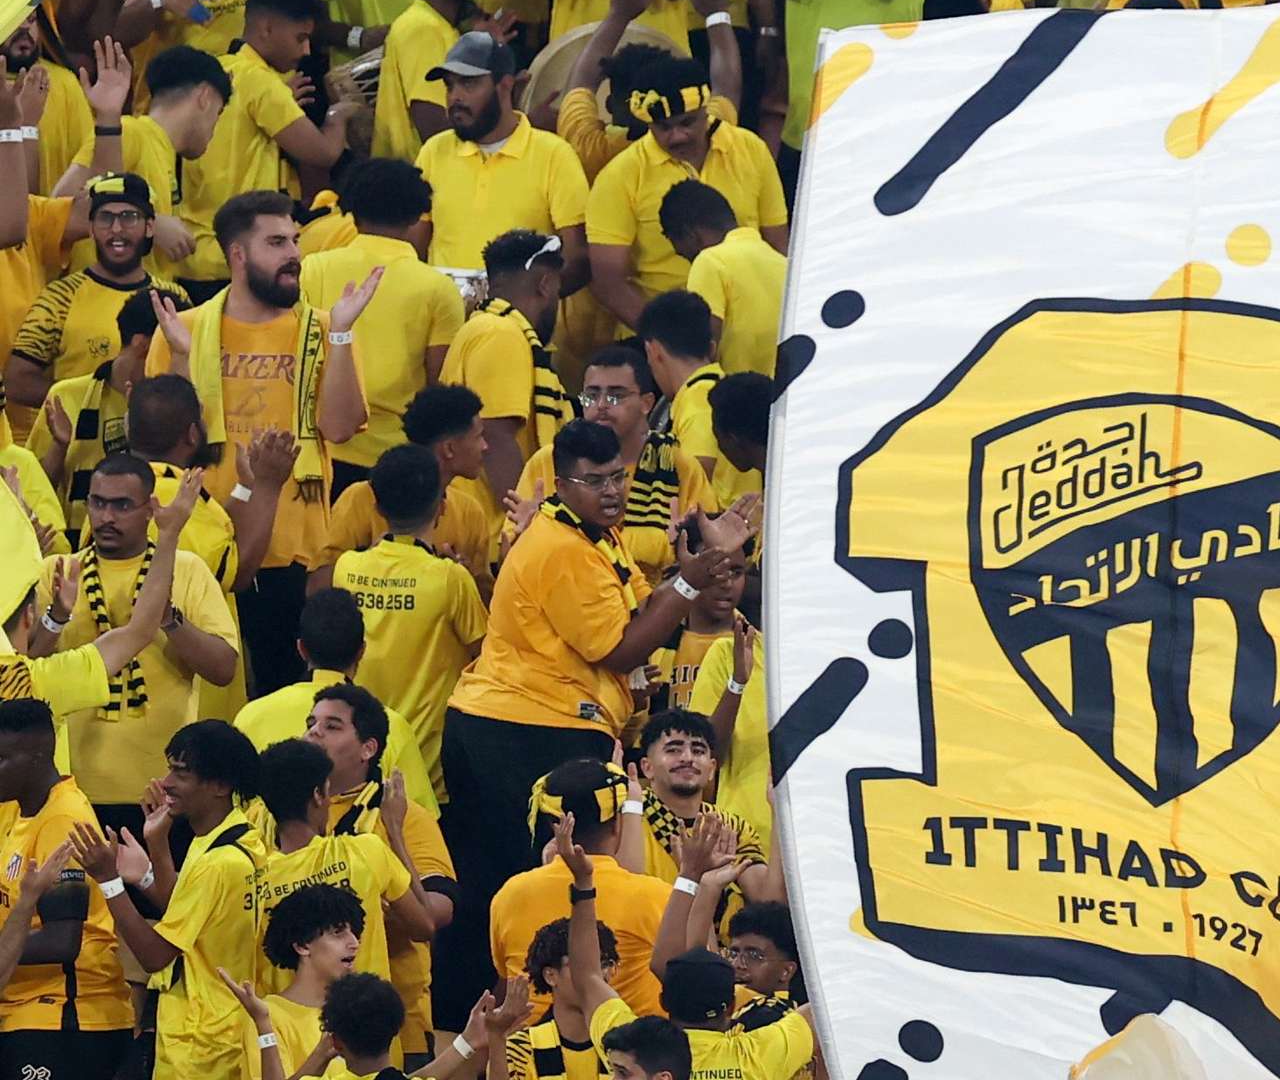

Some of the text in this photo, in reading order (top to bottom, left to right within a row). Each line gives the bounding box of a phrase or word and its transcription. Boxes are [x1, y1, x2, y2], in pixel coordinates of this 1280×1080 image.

[993, 413, 1203, 555] Jeddah
[1007, 532, 1158, 617] الاتحاد
[1192, 913, 1263, 958] 1927
